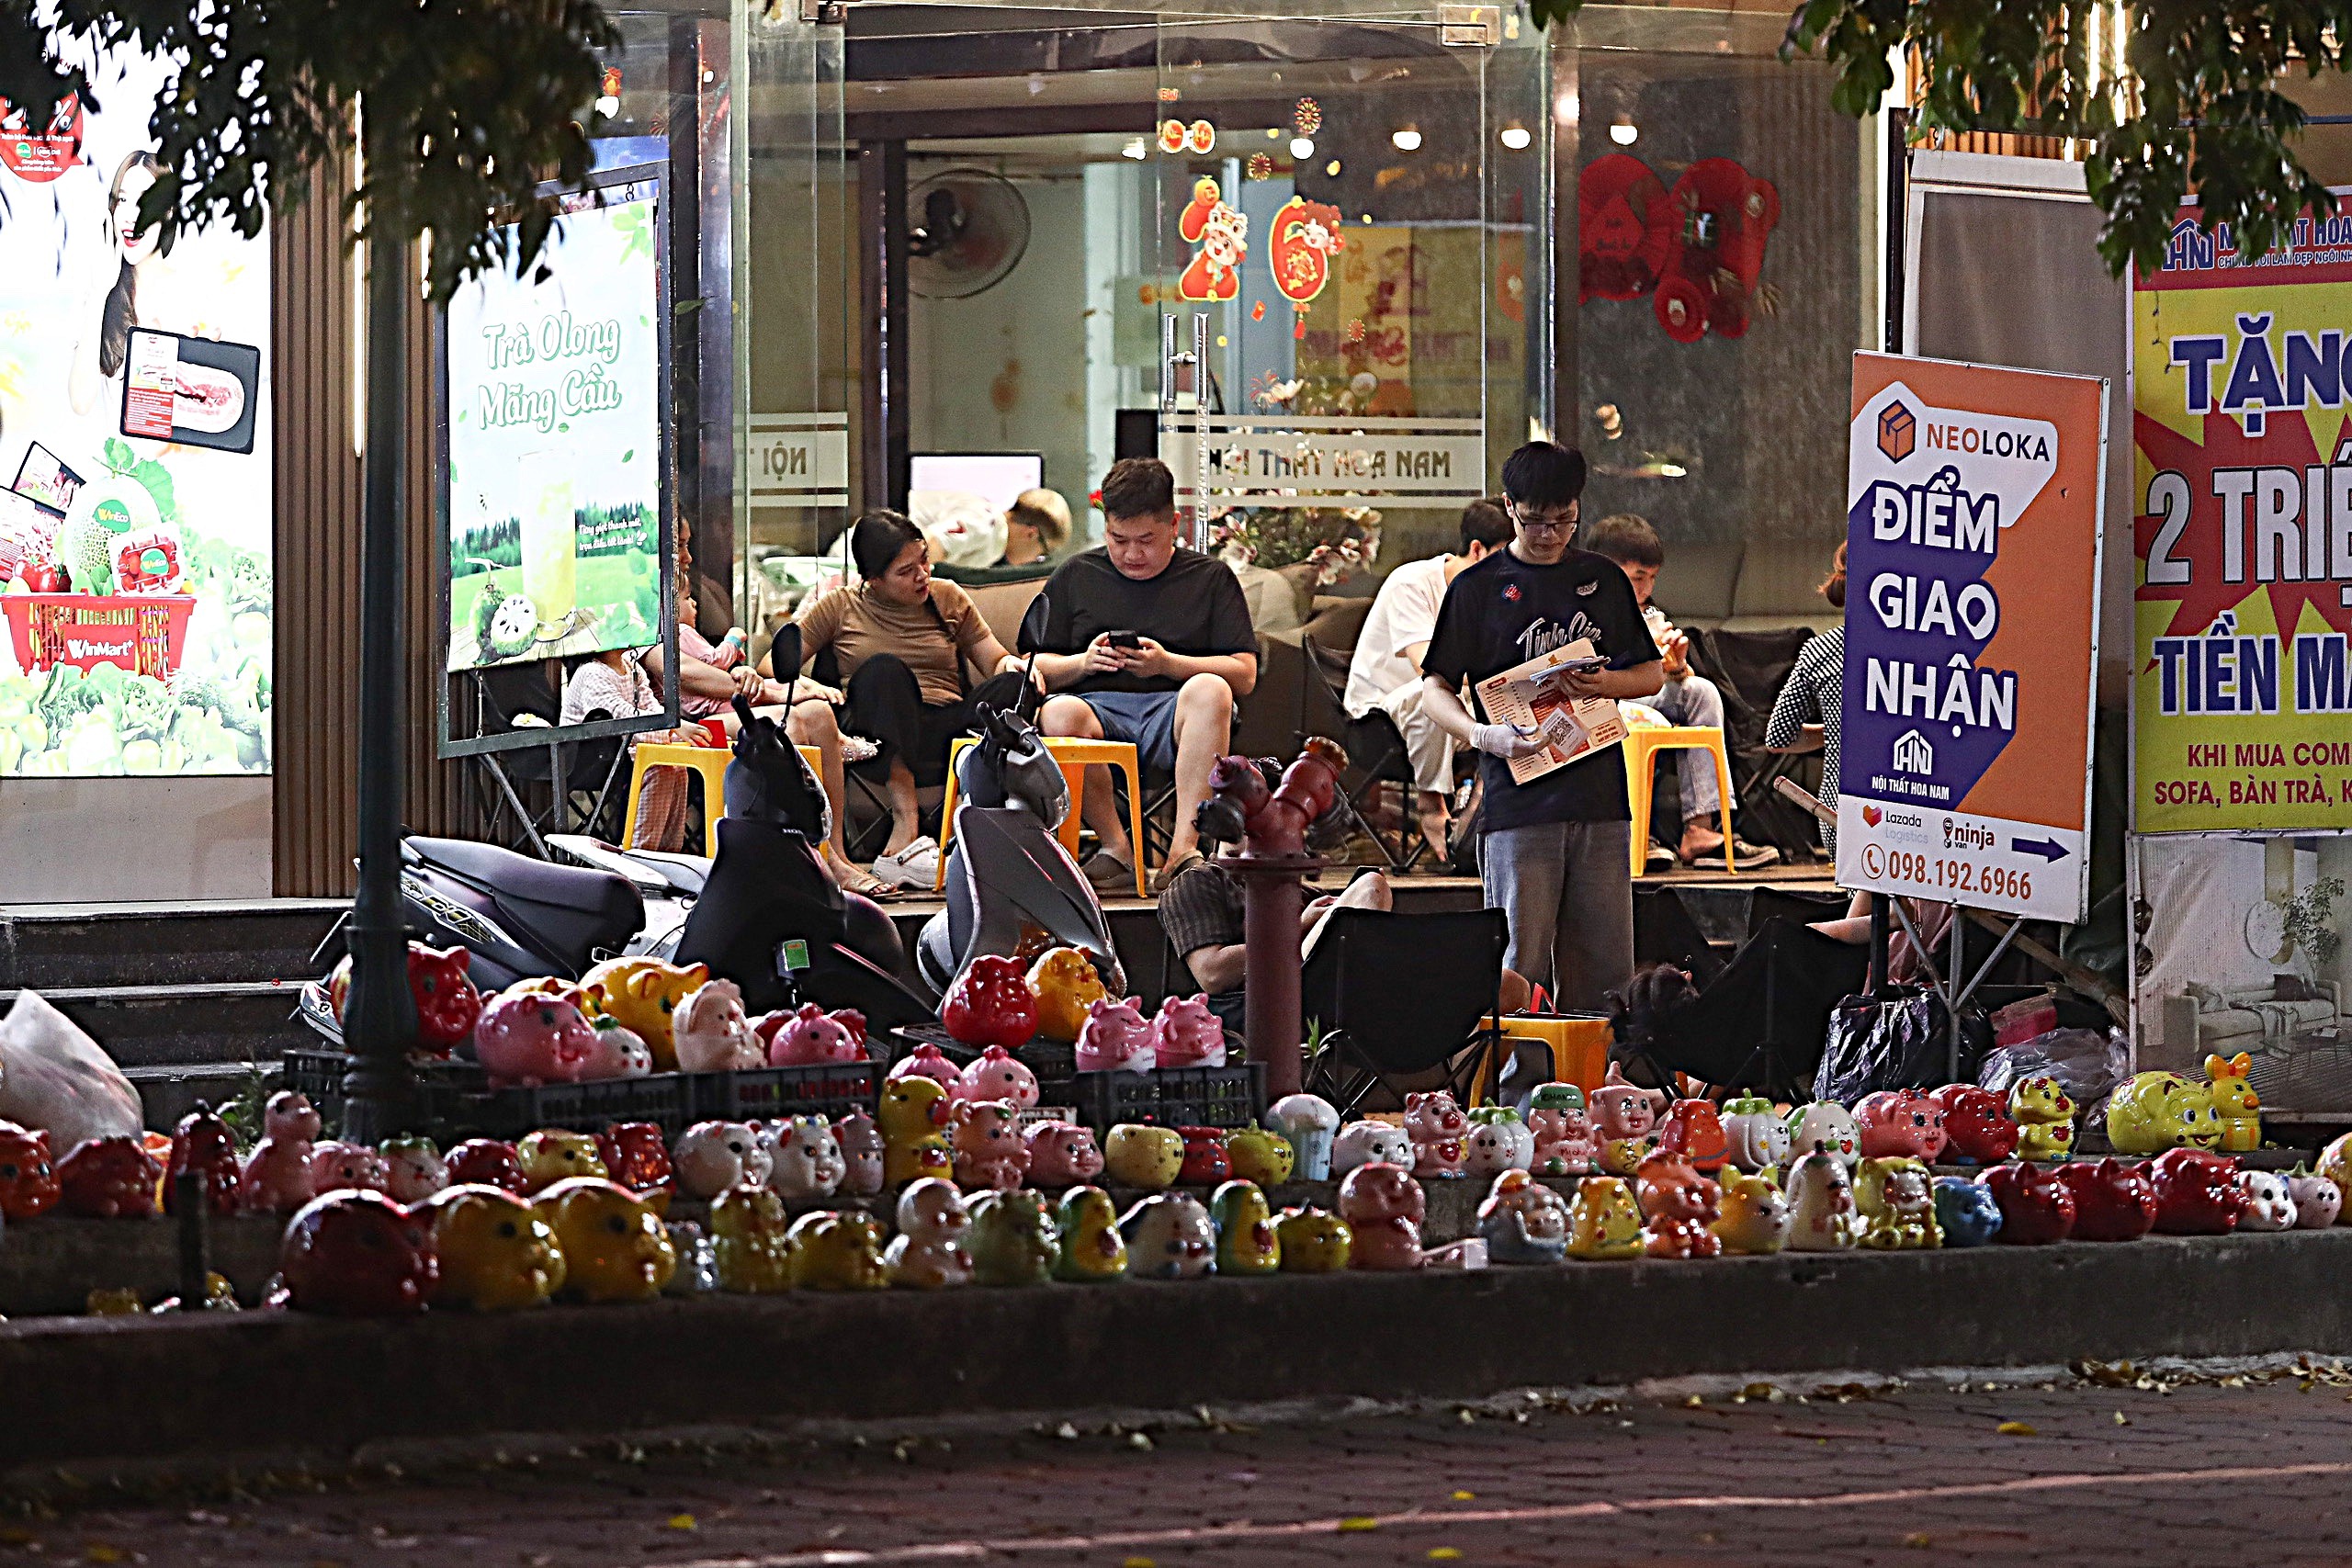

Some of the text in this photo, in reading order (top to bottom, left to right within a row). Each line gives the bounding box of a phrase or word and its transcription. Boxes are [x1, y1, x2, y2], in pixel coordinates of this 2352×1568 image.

[2315, 247, 2338, 264] NGÔI
[482, 310, 620, 369] Trà Olong
[478, 363, 622, 434] Mãng Cầu
[1927, 423, 2050, 462] NEOLOKA
[1396, 449, 1451, 479] NAM
[1872, 471, 1996, 554] ĐIỂM
[2145, 468, 2192, 585] 2
[1870, 572, 1996, 639] GIAO
[2154, 610, 2352, 716] TIỀN M
[1866, 653, 2014, 738] NHẬN
[2188, 744, 2227, 767] KHI
[2234, 743, 2286, 767] MUA
[1871, 776, 1950, 801] NỘI THẤT HOA NAM
[2154, 780, 2222, 808] SOFA,
[2230, 773, 2277, 804] BÀN
[2283, 773, 2334, 807] TRÀ,
[1885, 810, 1922, 828] Lazada
[1885, 828, 1928, 844] Logistics
[1954, 821, 1995, 851] ninja
[1954, 840, 1968, 850] van
[1889, 851, 2032, 900] 098.192.6966
